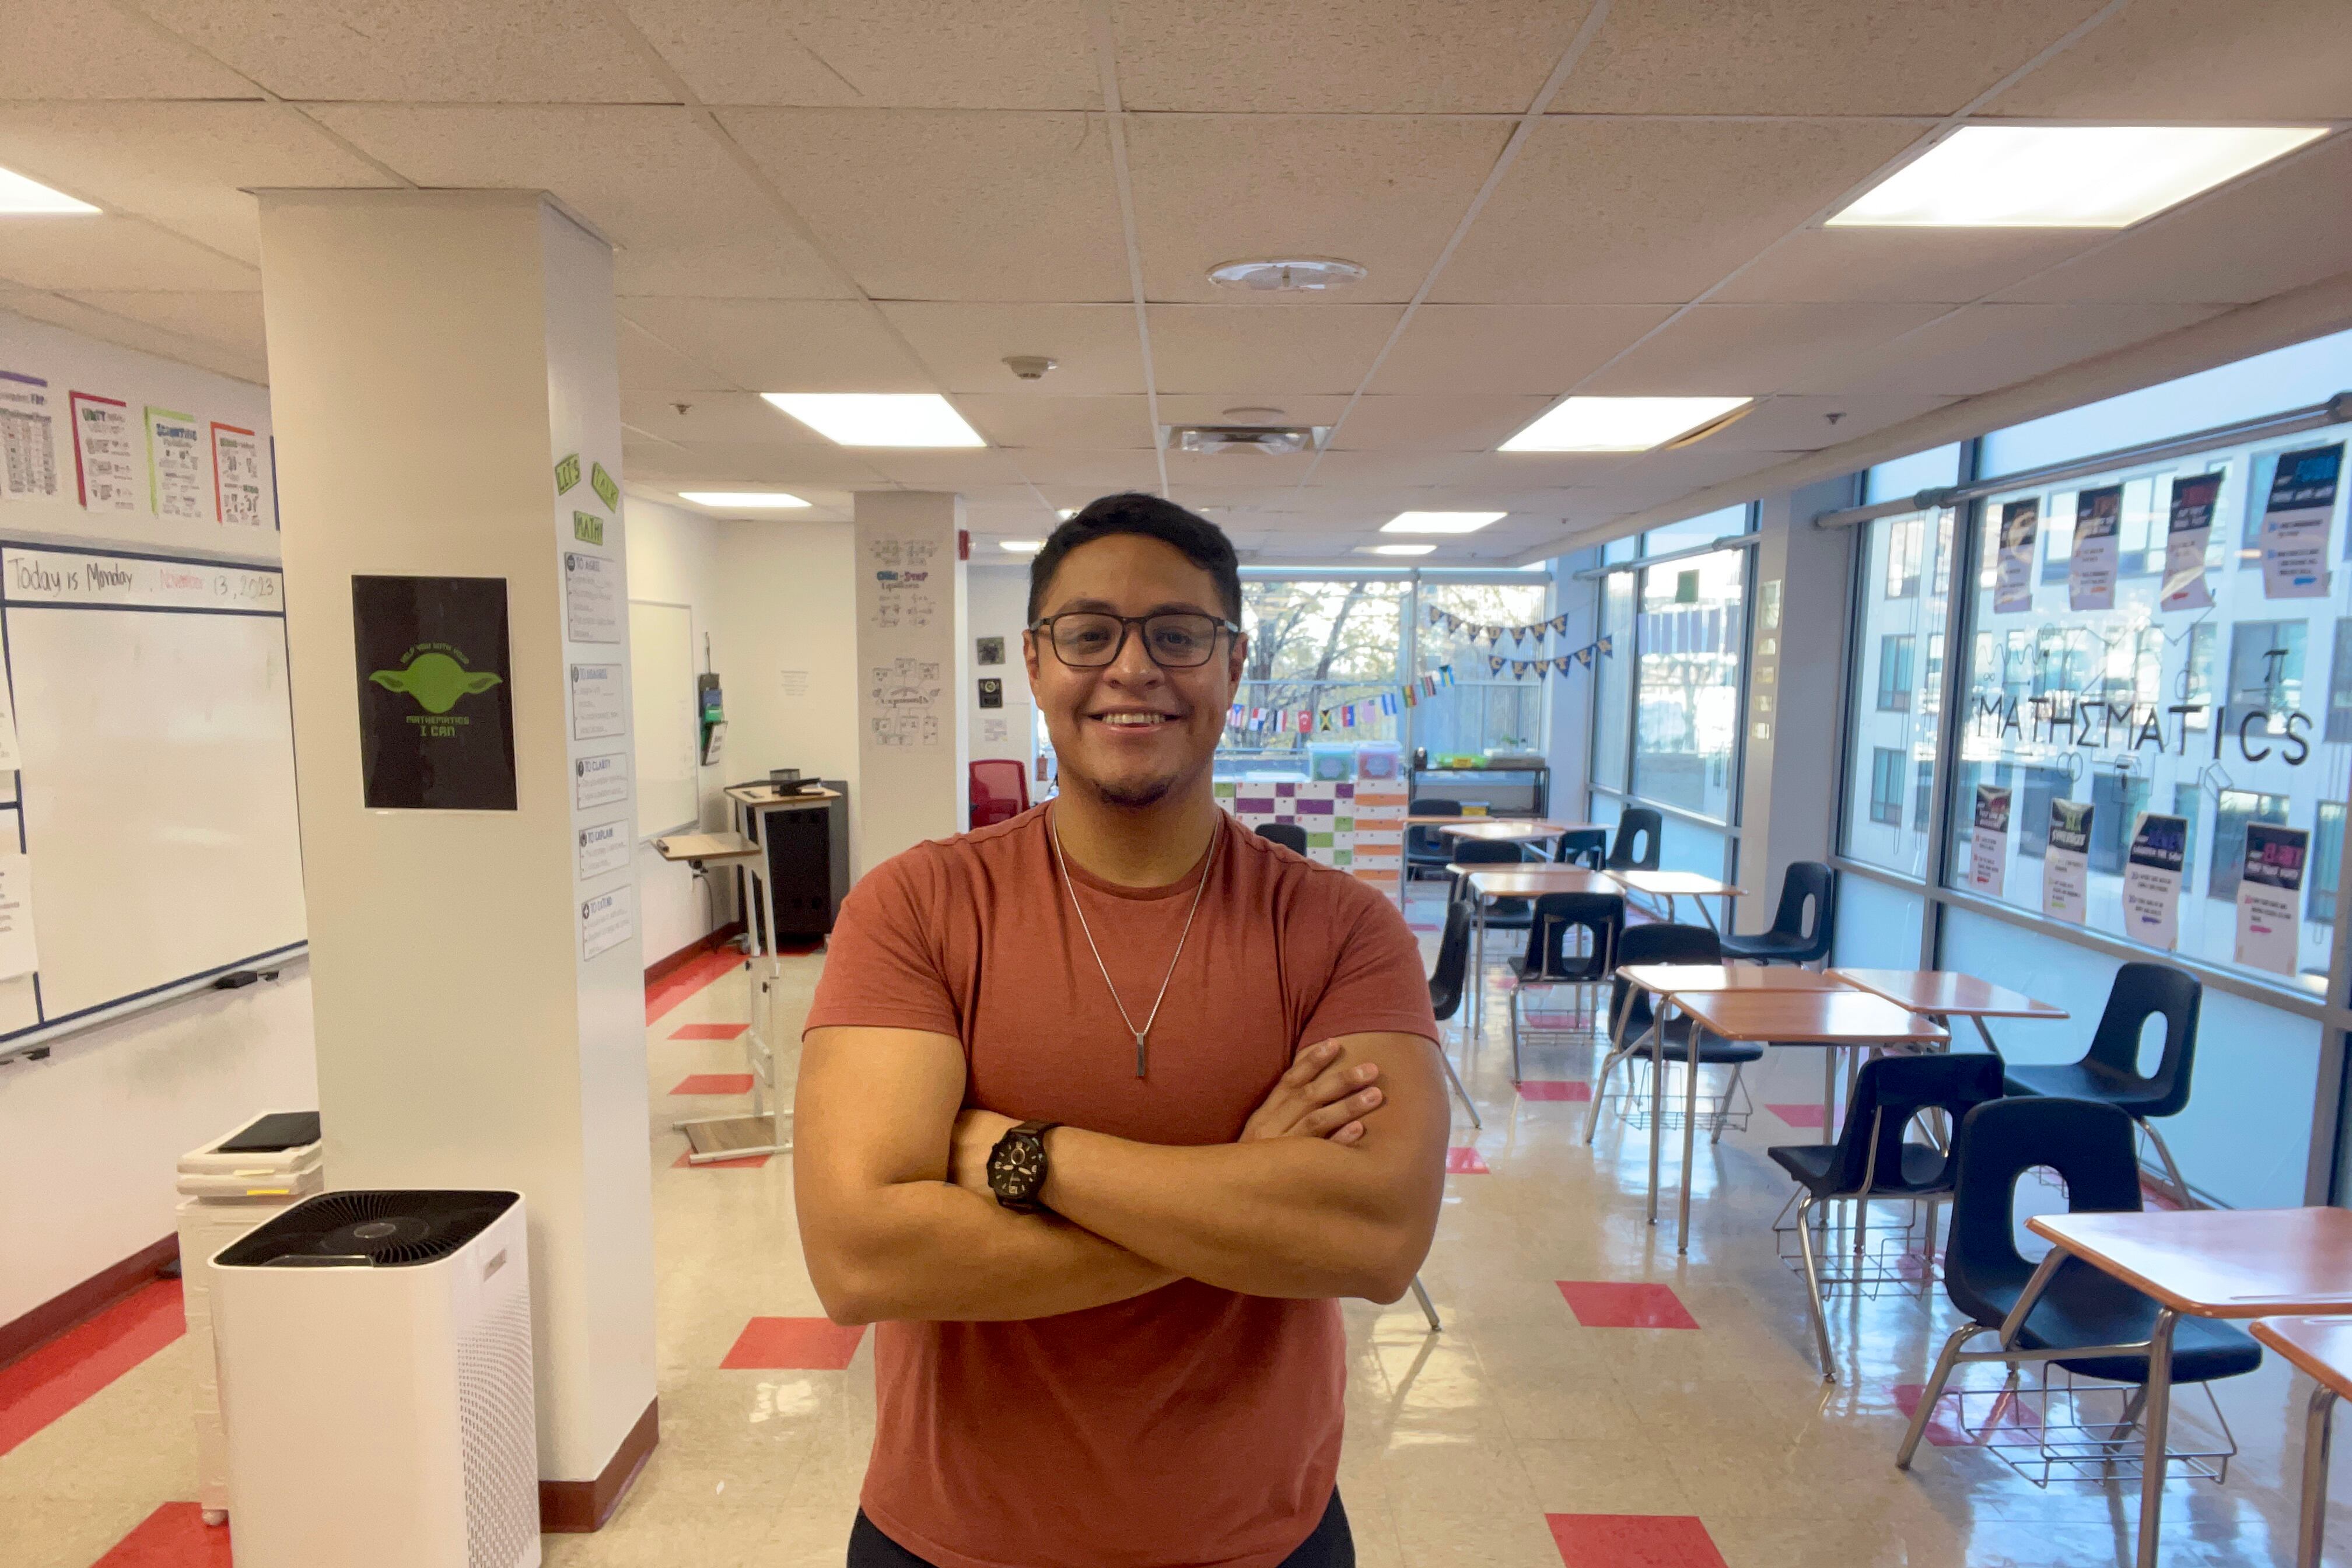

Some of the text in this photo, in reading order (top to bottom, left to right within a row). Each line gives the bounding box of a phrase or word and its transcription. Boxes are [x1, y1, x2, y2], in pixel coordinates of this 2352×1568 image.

[576, 514, 603, 542] MATH
[8, 557, 61, 598] Today
[67, 571, 78, 591] is
[86, 562, 133, 592] Monday
[240, 575, 274, 599] 2023
[1431, 607, 1567, 640] STUDENT
[1491, 638, 1613, 676] CENTER
[430, 726, 455, 737] CAN
